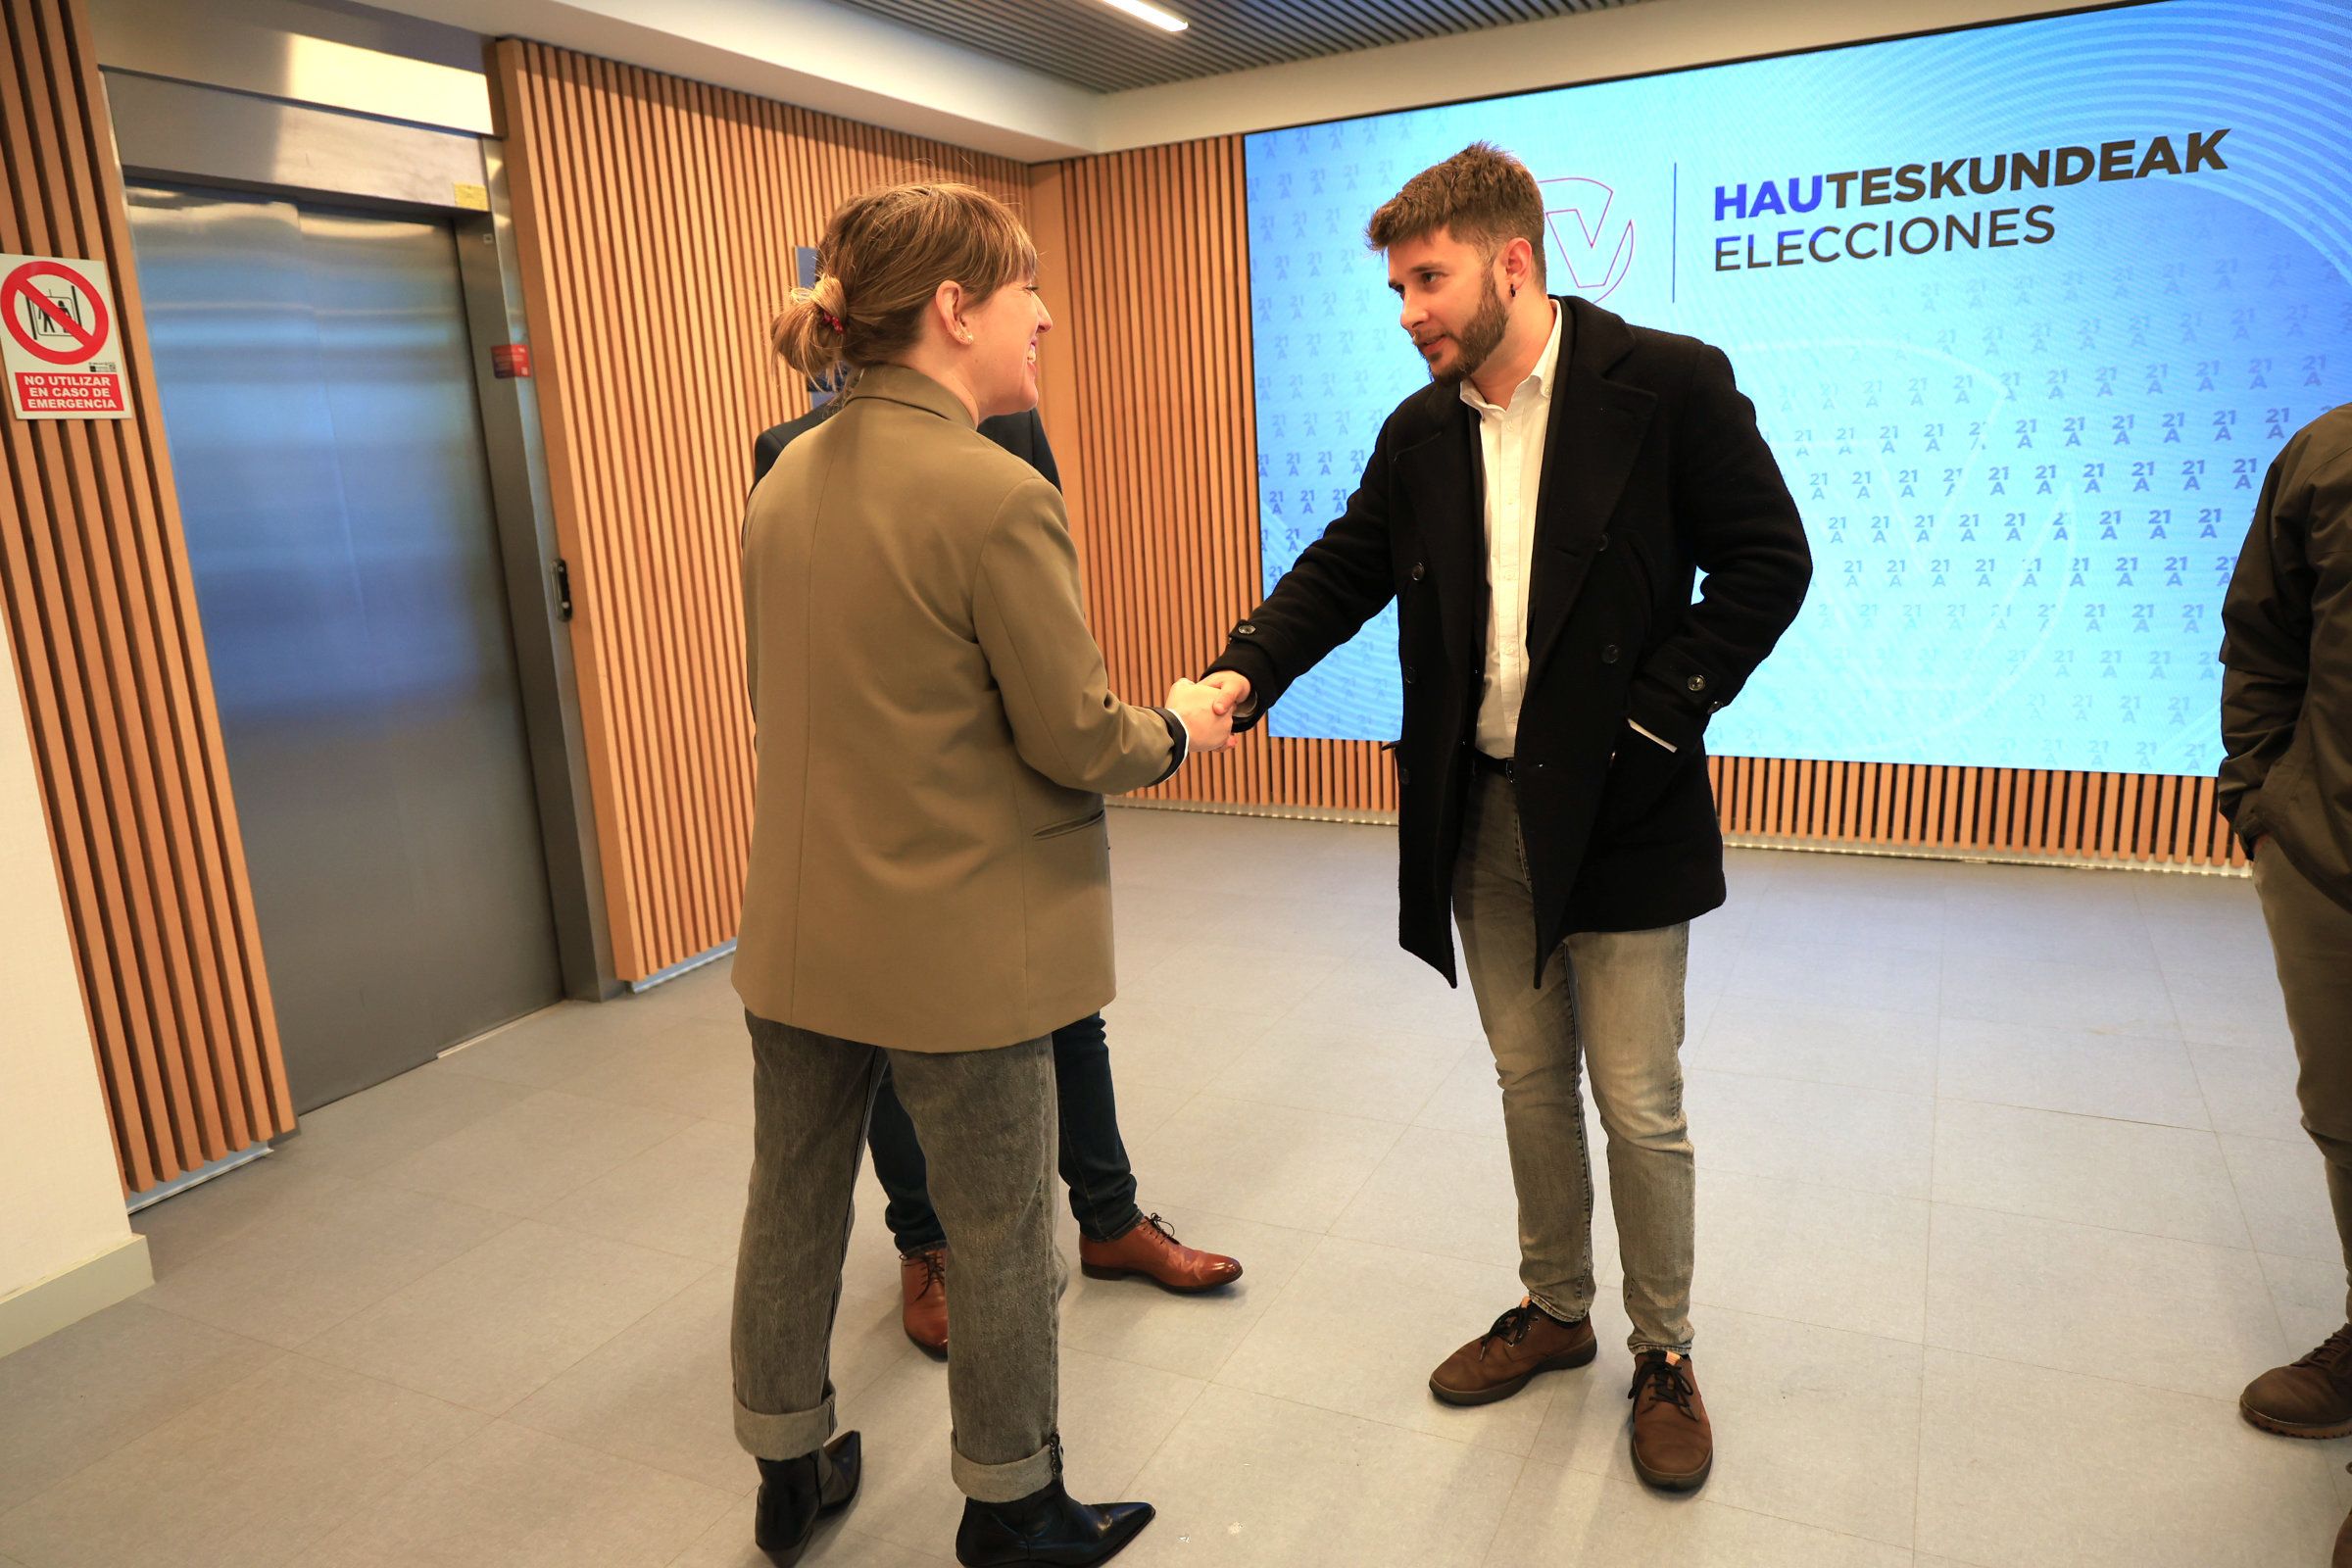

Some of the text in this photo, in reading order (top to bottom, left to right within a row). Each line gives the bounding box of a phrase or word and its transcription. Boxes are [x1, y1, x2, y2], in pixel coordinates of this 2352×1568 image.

[1715, 128, 2232, 220] HAUTESKUNDEAK
[1716, 205, 2055, 271] ELECCIONES
[2129, 315, 2150, 331] 21
[2180, 312, 2201, 328] 21
[2230, 308, 2254, 324] 21
[2030, 323, 2051, 337] 21
[2078, 318, 2100, 334] 21
[1983, 326, 2003, 341] 21
[2196, 361, 2219, 376] 21
[2249, 359, 2272, 373] 21
[2302, 355, 2327, 370] 21
[2048, 369, 2067, 384] 21
[2095, 368, 2117, 382] 21
[2145, 365, 2168, 378] 21
[24, 376, 112, 386] NO UTILIZAR
[1909, 377, 1927, 392] 21
[1953, 375, 1973, 389] 21
[2147, 380, 2163, 394] A
[2197, 376, 2214, 392] A
[2250, 373, 2267, 389] A
[28, 387, 111, 398] EN CASO DE
[2048, 385, 2064, 399] A
[2096, 382, 2113, 397] A
[27, 398, 118, 409] EMERGENCIA
[1911, 392, 1924, 406] A
[1955, 390, 1970, 404] A
[2113, 415, 2133, 429] 21
[2162, 413, 2184, 427] 21
[2213, 411, 2235, 425] 21
[2266, 408, 2288, 422] 21
[1924, 423, 1943, 437] 21
[2016, 419, 2036, 433] 21
[2063, 417, 2084, 432] 21
[2268, 424, 2283, 438] A
[1795, 429, 1812, 441] 21
[1836, 427, 1854, 440] 21
[1880, 426, 1898, 439] 21
[2066, 432, 2081, 446] A
[2114, 429, 2130, 445] A
[2164, 427, 2180, 443] A
[2215, 425, 2231, 441] A
[1882, 440, 1895, 454] A
[1926, 437, 1940, 452] A
[2017, 433, 2033, 449] A
[1795, 444, 1809, 458] A
[1838, 442, 1852, 456] A
[1287, 453, 1300, 465] 21
[1318, 451, 1332, 463] 21
[1350, 450, 1364, 463] 21
[1288, 465, 1299, 476] A
[1319, 464, 1332, 475] A
[1351, 463, 1362, 473] A
[1989, 466, 2009, 480] 21
[2035, 465, 2056, 479] 21
[2083, 464, 2104, 477] 21
[2132, 462, 2154, 476] 21
[2181, 460, 2204, 475] 21
[2233, 459, 2256, 473] 21
[1810, 472, 1828, 486] 21
[1852, 471, 1871, 484] 21
[1899, 469, 1917, 483] 21
[2184, 475, 2200, 490] A
[2234, 474, 2251, 489] A
[1901, 485, 1915, 497] A
[1990, 482, 2005, 495] A
[2036, 480, 2051, 495] A
[2084, 479, 2100, 493] A
[2133, 477, 2149, 492] A
[1269, 491, 1283, 503] 21
[1300, 490, 1314, 503] 21
[1333, 489, 1347, 502] 21
[1812, 487, 1825, 500] A
[1857, 486, 1870, 499] A
[1272, 503, 1283, 514] A
[1301, 503, 1314, 514] A
[1334, 502, 1346, 513] A
[1829, 516, 1846, 529] 21
[1871, 515, 1889, 529] 21
[1915, 514, 1934, 528] 21
[1959, 514, 1979, 527] 21
[2005, 513, 2025, 526] 21
[2100, 511, 2121, 524] 21
[2148, 510, 2171, 523] 21
[2199, 509, 2221, 522] 21
[1286, 528, 1299, 540] 21
[1831, 531, 1843, 543] A
[1873, 529, 1886, 543] A
[1917, 529, 1929, 542] A
[1961, 529, 1975, 542] A
[2007, 527, 2021, 541] A
[2101, 526, 2117, 540] A
[2150, 525, 2166, 539] A
[2201, 524, 2217, 538] A
[1287, 540, 1299, 552] A
[1844, 560, 1862, 573] 21
[1886, 559, 1905, 572] 21
[1932, 559, 1949, 572] 21
[1976, 559, 1994, 572] 21
[2116, 558, 2137, 571] 21
[2165, 557, 2186, 571] 21
[1845, 574, 1858, 587] A
[1889, 575, 1902, 587] A
[1933, 574, 1945, 587] A
[1978, 573, 1990, 586] A
[2117, 572, 2132, 586] A
[2167, 572, 2181, 586] A
[2084, 604, 2105, 617] 21
[2132, 604, 2154, 618] 21
[2182, 605, 2203, 618] 21
[2087, 618, 2100, 631] A
[2133, 618, 2149, 632] A
[2184, 618, 2199, 633] A
[2054, 650, 2074, 662] 21
[2100, 650, 2122, 663] 21
[2149, 651, 2170, 664] 21
[2102, 665, 2117, 678] A
[2149, 665, 2166, 679] A
[2121, 695, 2140, 710] 21
[2168, 697, 2189, 711] 21
[2123, 710, 2136, 723] A
[2169, 711, 2185, 725] A
